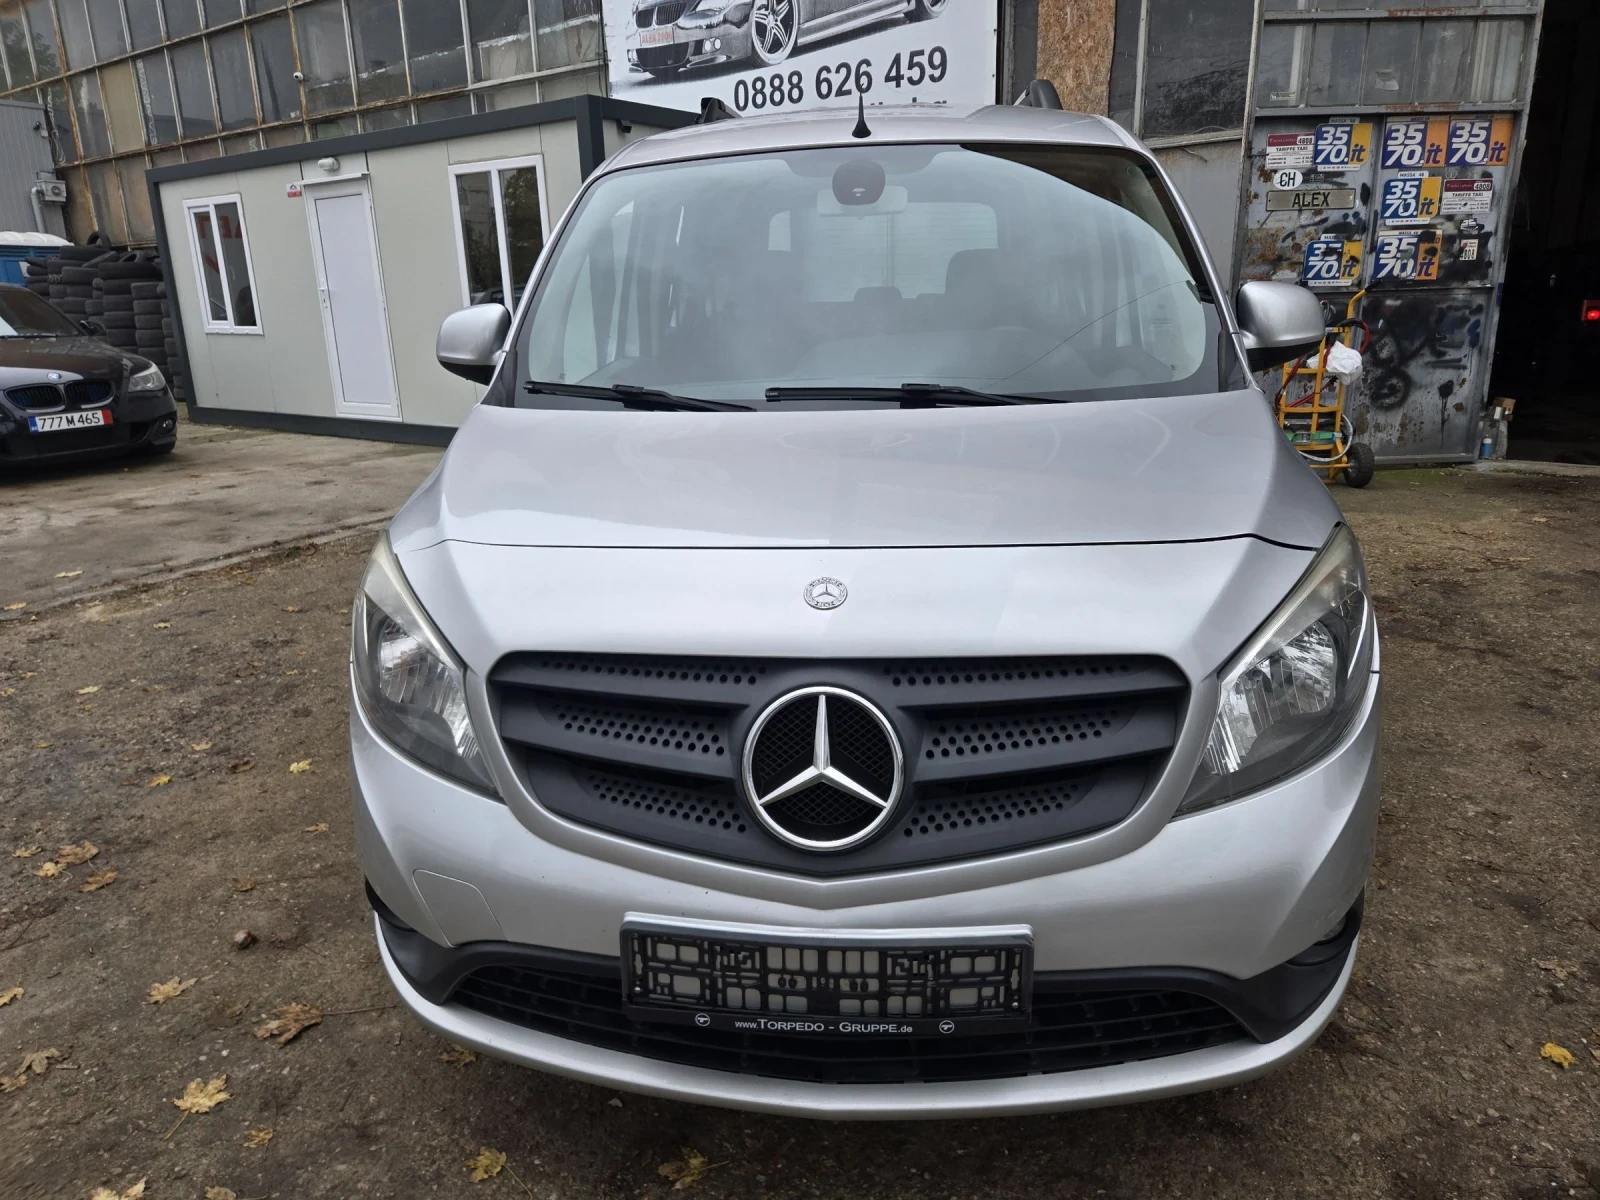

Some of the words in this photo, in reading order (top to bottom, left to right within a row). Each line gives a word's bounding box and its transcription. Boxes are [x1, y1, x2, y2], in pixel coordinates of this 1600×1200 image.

[734, 70, 804, 112] 0888
[815, 58, 873, 100] 626
[884, 45, 948, 89] 459
[1318, 126, 1351, 145] 35
[1387, 123, 1425, 145] 35
[1451, 121, 1490, 143] 35
[1280, 171, 1296, 187] CH
[1385, 180, 1420, 199] 35
[1292, 191, 1331, 208] ALEX
[1379, 237, 1418, 259] 35
[39, 416, 63, 430] 777
[65, 415, 76, 427] M
[77, 412, 101, 425] 465
[735, 1019, 825, 1032] www.TORPEDO
[839, 1021, 913, 1033] GRUPPE.de
